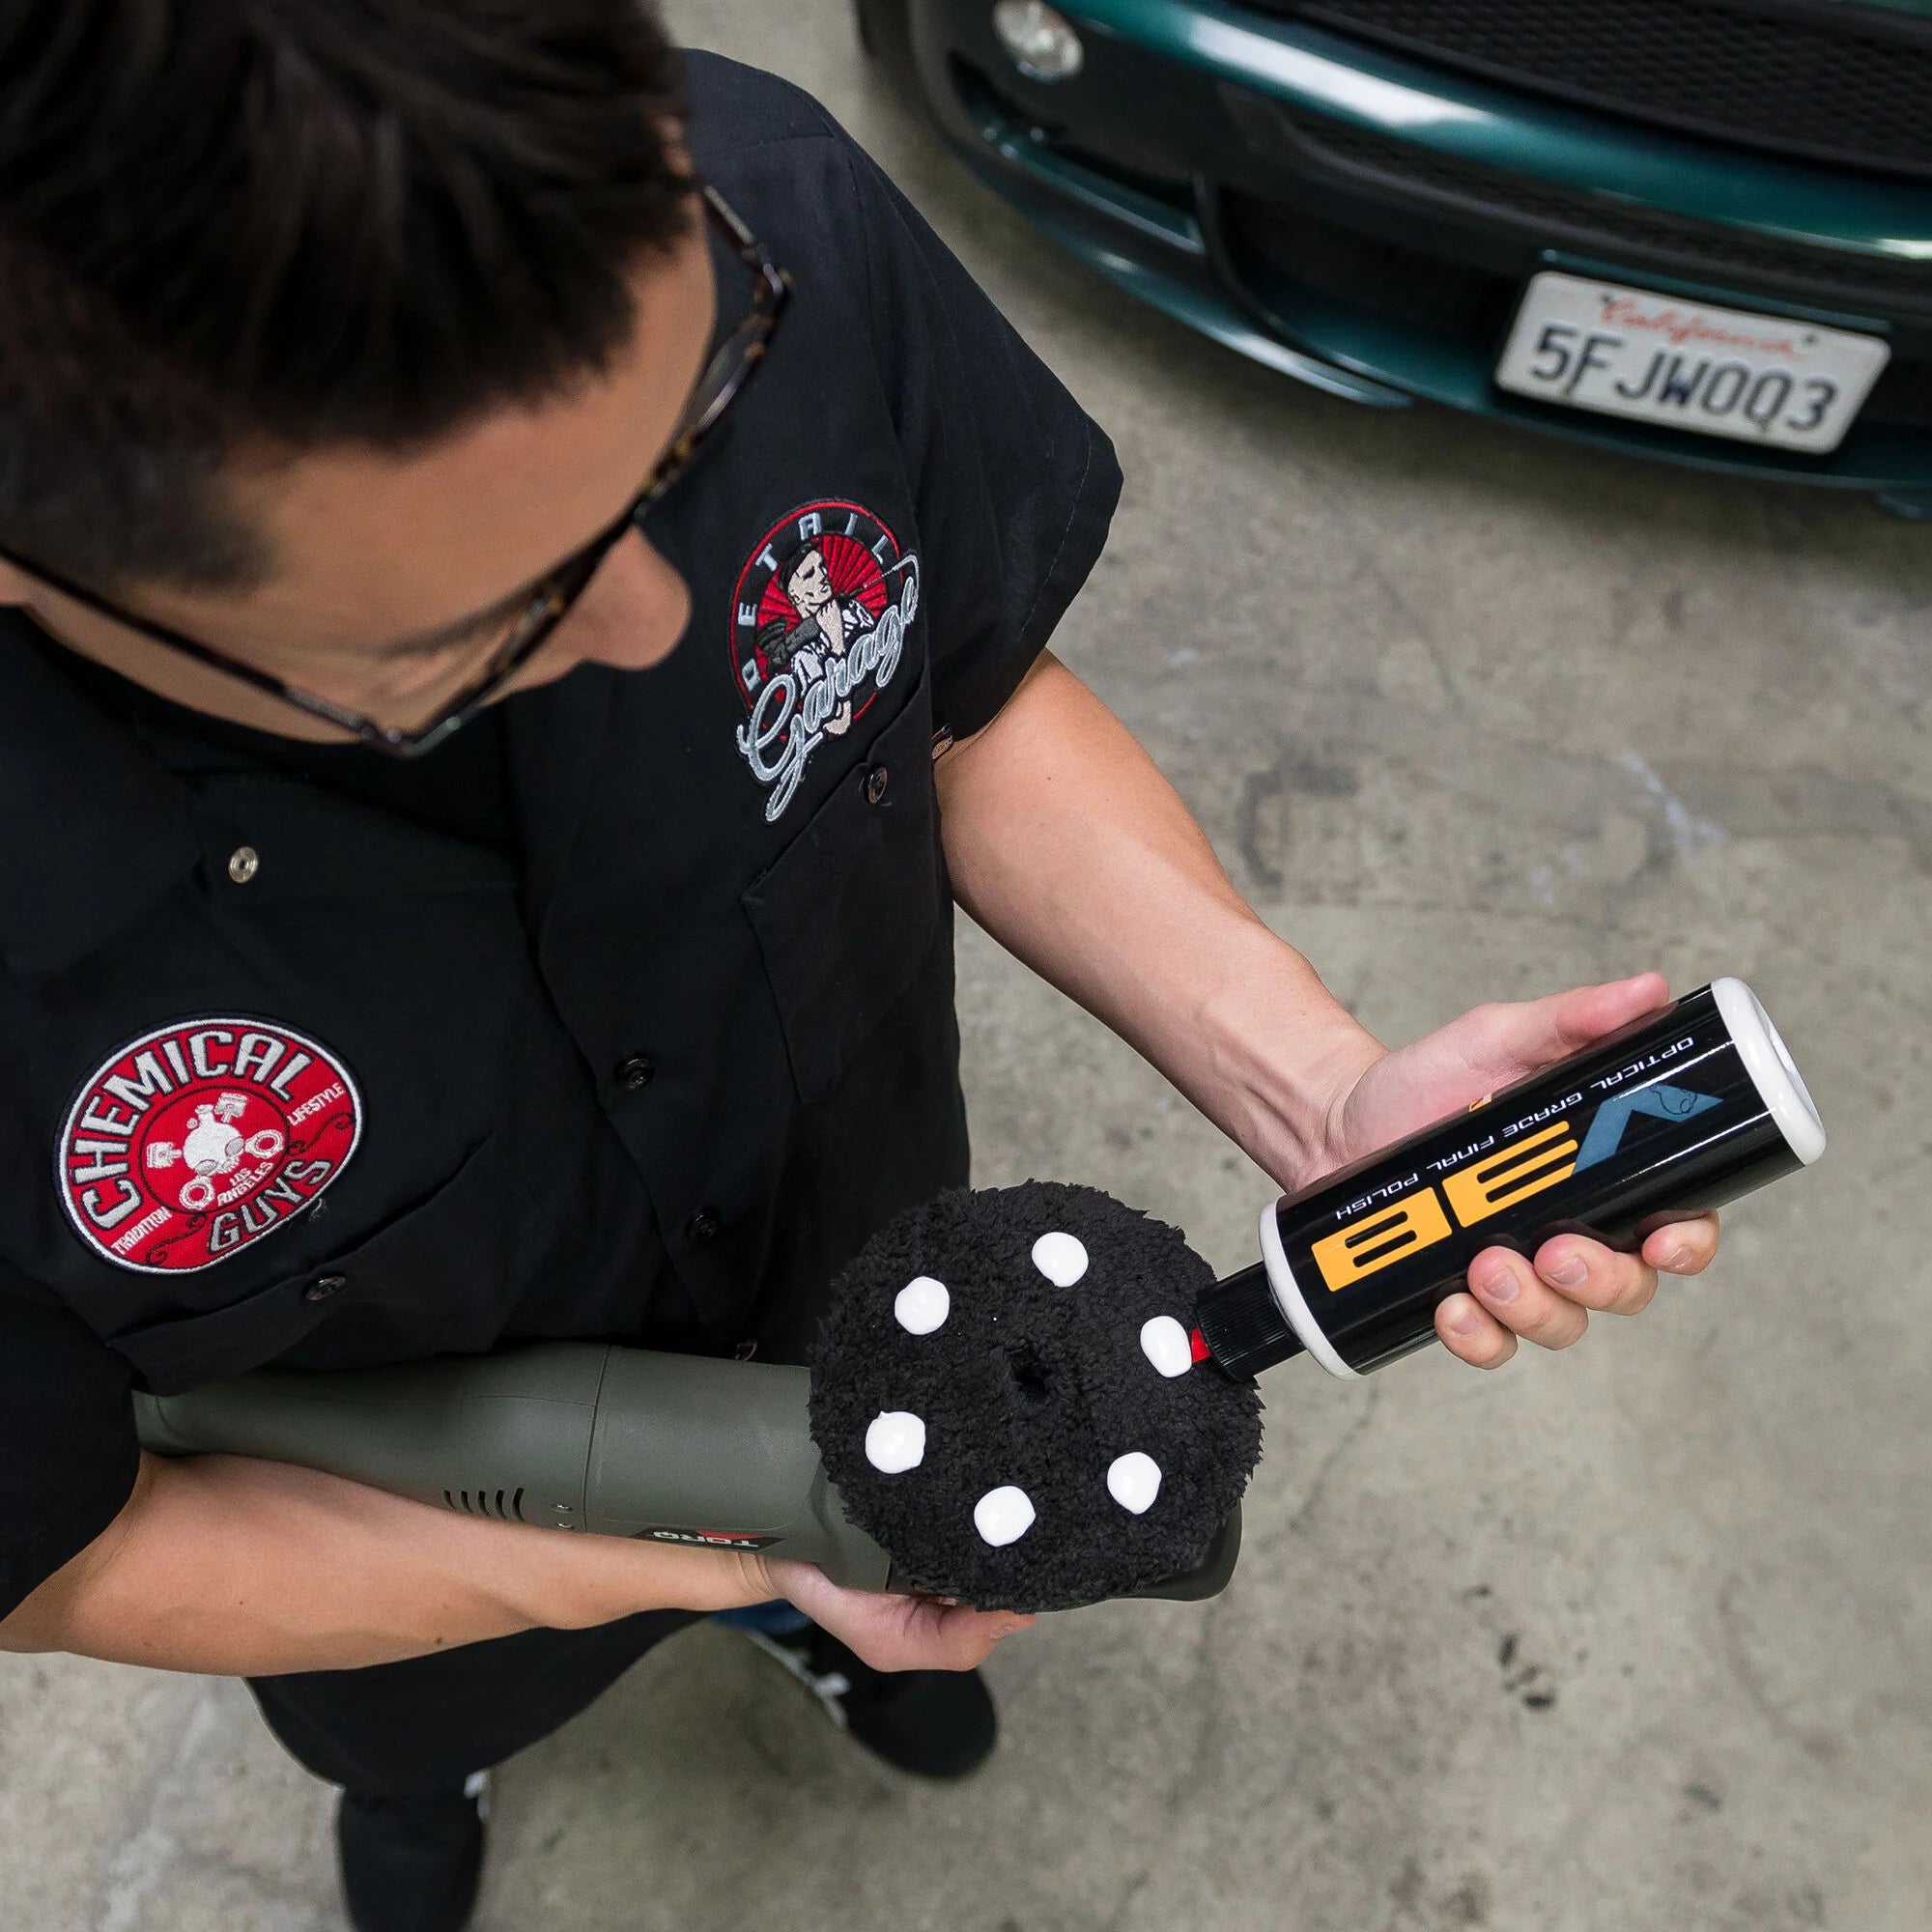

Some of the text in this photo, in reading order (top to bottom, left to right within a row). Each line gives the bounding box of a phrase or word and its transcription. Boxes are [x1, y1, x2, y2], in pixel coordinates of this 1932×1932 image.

[737, 512, 888, 692] DETAIL
[737, 552, 920, 821] Garage
[73, 1030, 312, 1230] CHEMICAL
[288, 1082, 345, 1127] LIFESTYLE
[1335, 1036, 1694, 1220] OPTICAL GRADE FINAL POLISH
[208, 1160, 332, 1254] GUYS
[217, 1162, 273, 1207] ANGELES
[229, 1167, 252, 1187] LOS
[111, 1206, 172, 1256] TRADITION
